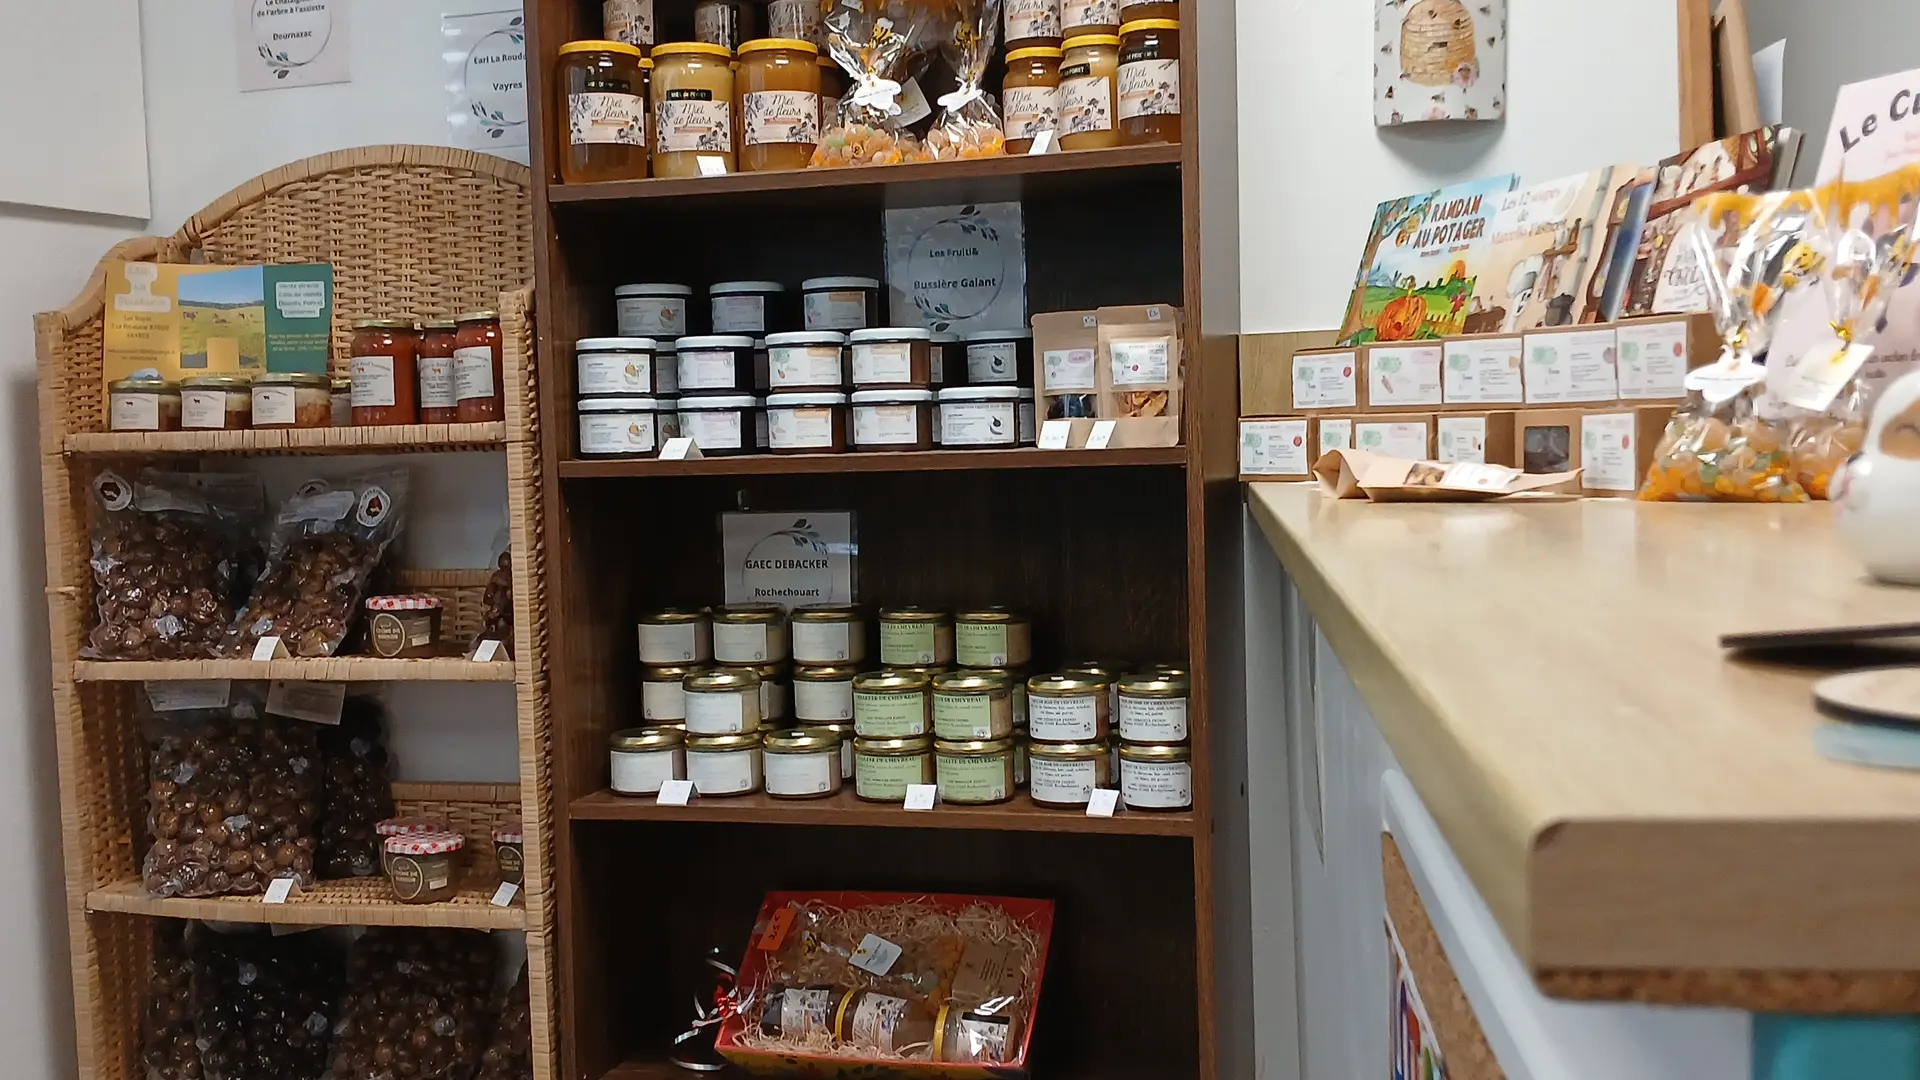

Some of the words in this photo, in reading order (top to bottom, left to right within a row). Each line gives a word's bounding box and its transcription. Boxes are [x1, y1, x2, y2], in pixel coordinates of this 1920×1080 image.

[272, 30, 312, 41] Dournazac
[490, 55, 500, 63] La
[1126, 67, 1147, 78] Miel
[492, 81, 523, 92] Vayres
[1127, 78, 1154, 95] fleurs
[600, 95, 622, 107] Miel
[773, 94, 796, 106] Miel
[1012, 91, 1032, 102] Miel
[591, 109, 601, 118] de
[603, 106, 629, 120] fleurs
[682, 103, 704, 114] Miel
[764, 107, 774, 116] de
[774, 105, 802, 119] fleurs
[1013, 102, 1038, 117] fleurs
[674, 116, 684, 125] de
[684, 113, 711, 128] fleurs
[1839, 114, 1878, 153] Le
[1430, 194, 1483, 223] RAMDAM
[1412, 227, 1432, 250] AU
[1431, 217, 1486, 246] POTAGER
[929, 248, 945, 258] Les
[914, 278, 958, 290] Bussière
[961, 277, 997, 288] Galant
[745, 559, 773, 570] GAEC
[775, 559, 829, 570] DEBACKER
[754, 587, 820, 598] Rochechouart
